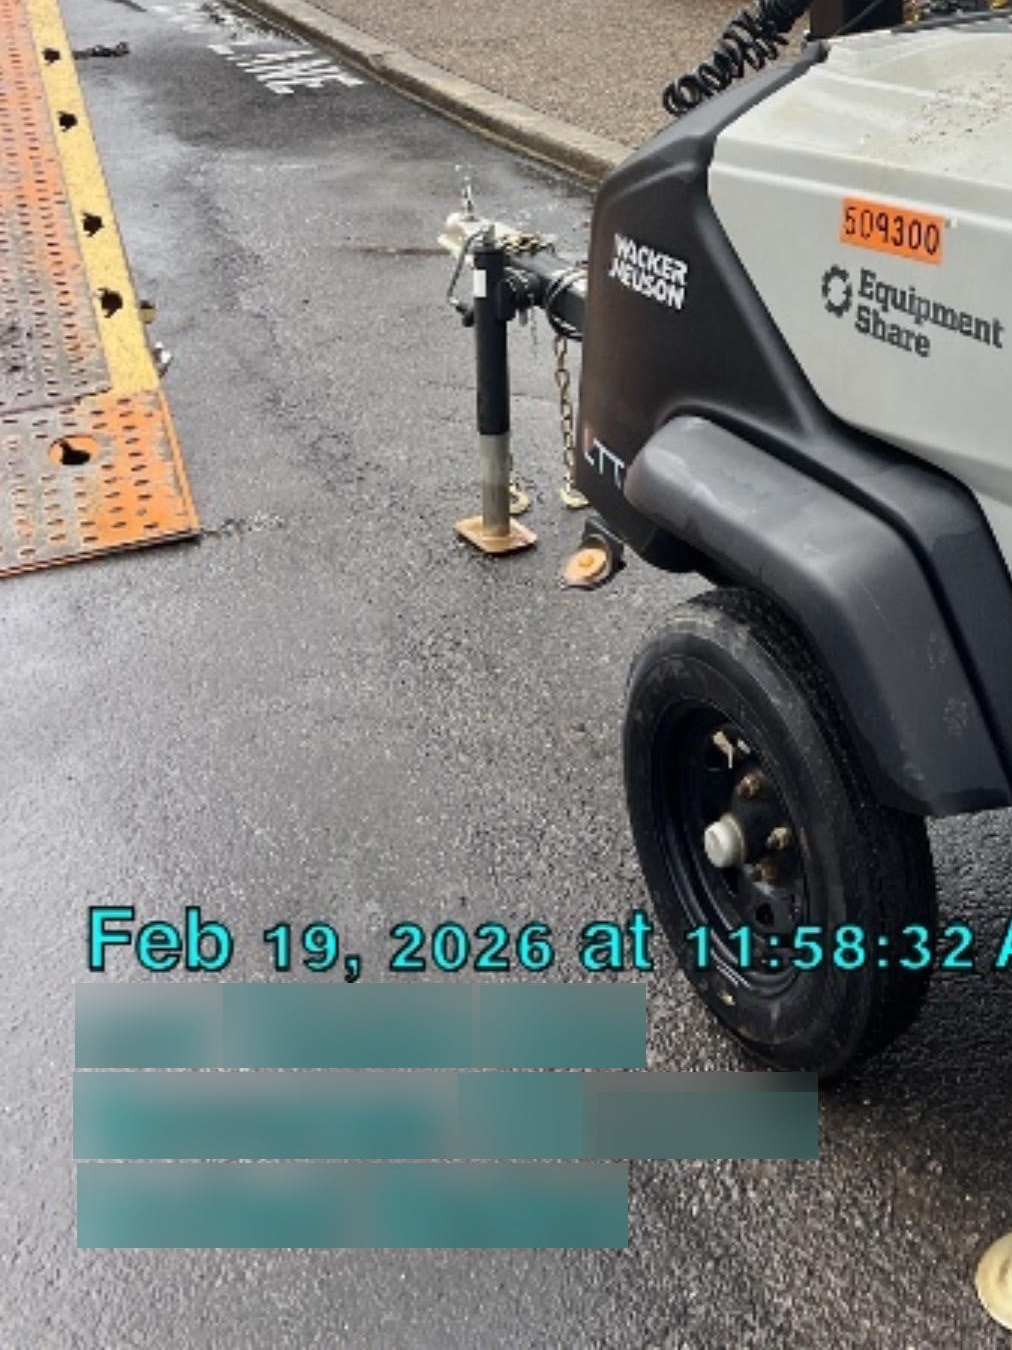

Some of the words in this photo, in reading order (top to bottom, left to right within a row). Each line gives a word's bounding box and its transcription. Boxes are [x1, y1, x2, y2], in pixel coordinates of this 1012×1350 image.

[845, 206, 941, 256] 509300
[608, 257, 685, 310] NEUSON
[614, 233, 688, 285] WACKER
[855, 304, 931, 357] Share
[858, 267, 1005, 349] Equipment
